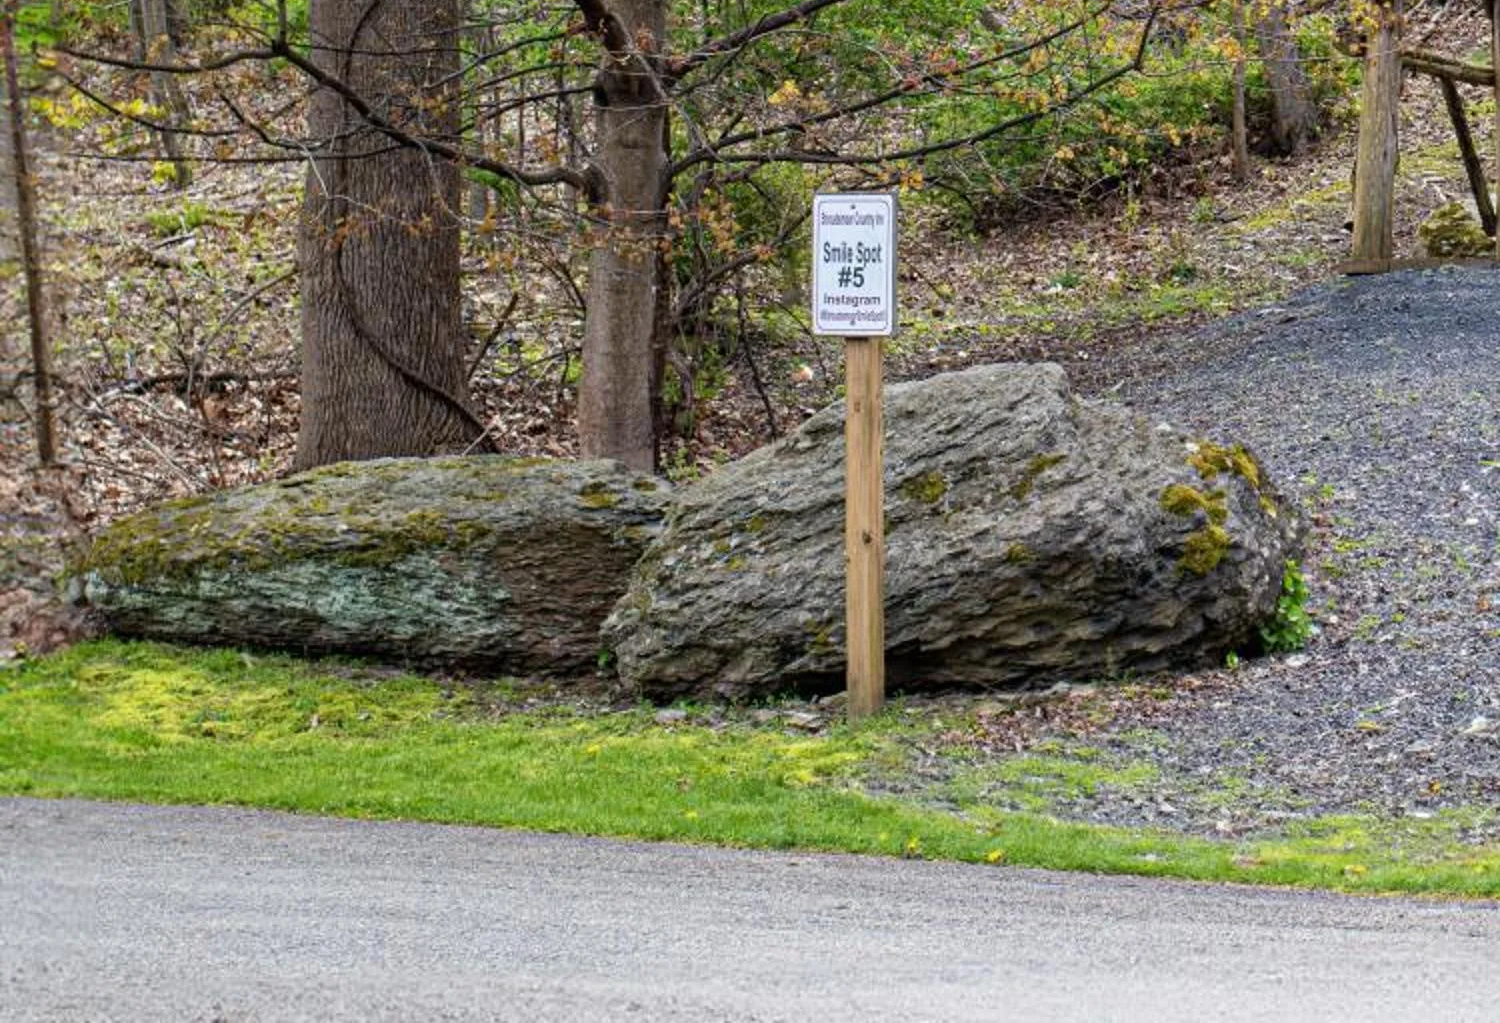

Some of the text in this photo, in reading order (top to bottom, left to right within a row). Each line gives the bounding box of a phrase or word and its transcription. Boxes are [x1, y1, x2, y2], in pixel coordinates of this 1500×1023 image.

[823, 241, 882, 268] Smile Spot
[837, 266, 865, 288] #5
[823, 292, 881, 308] Instagram
